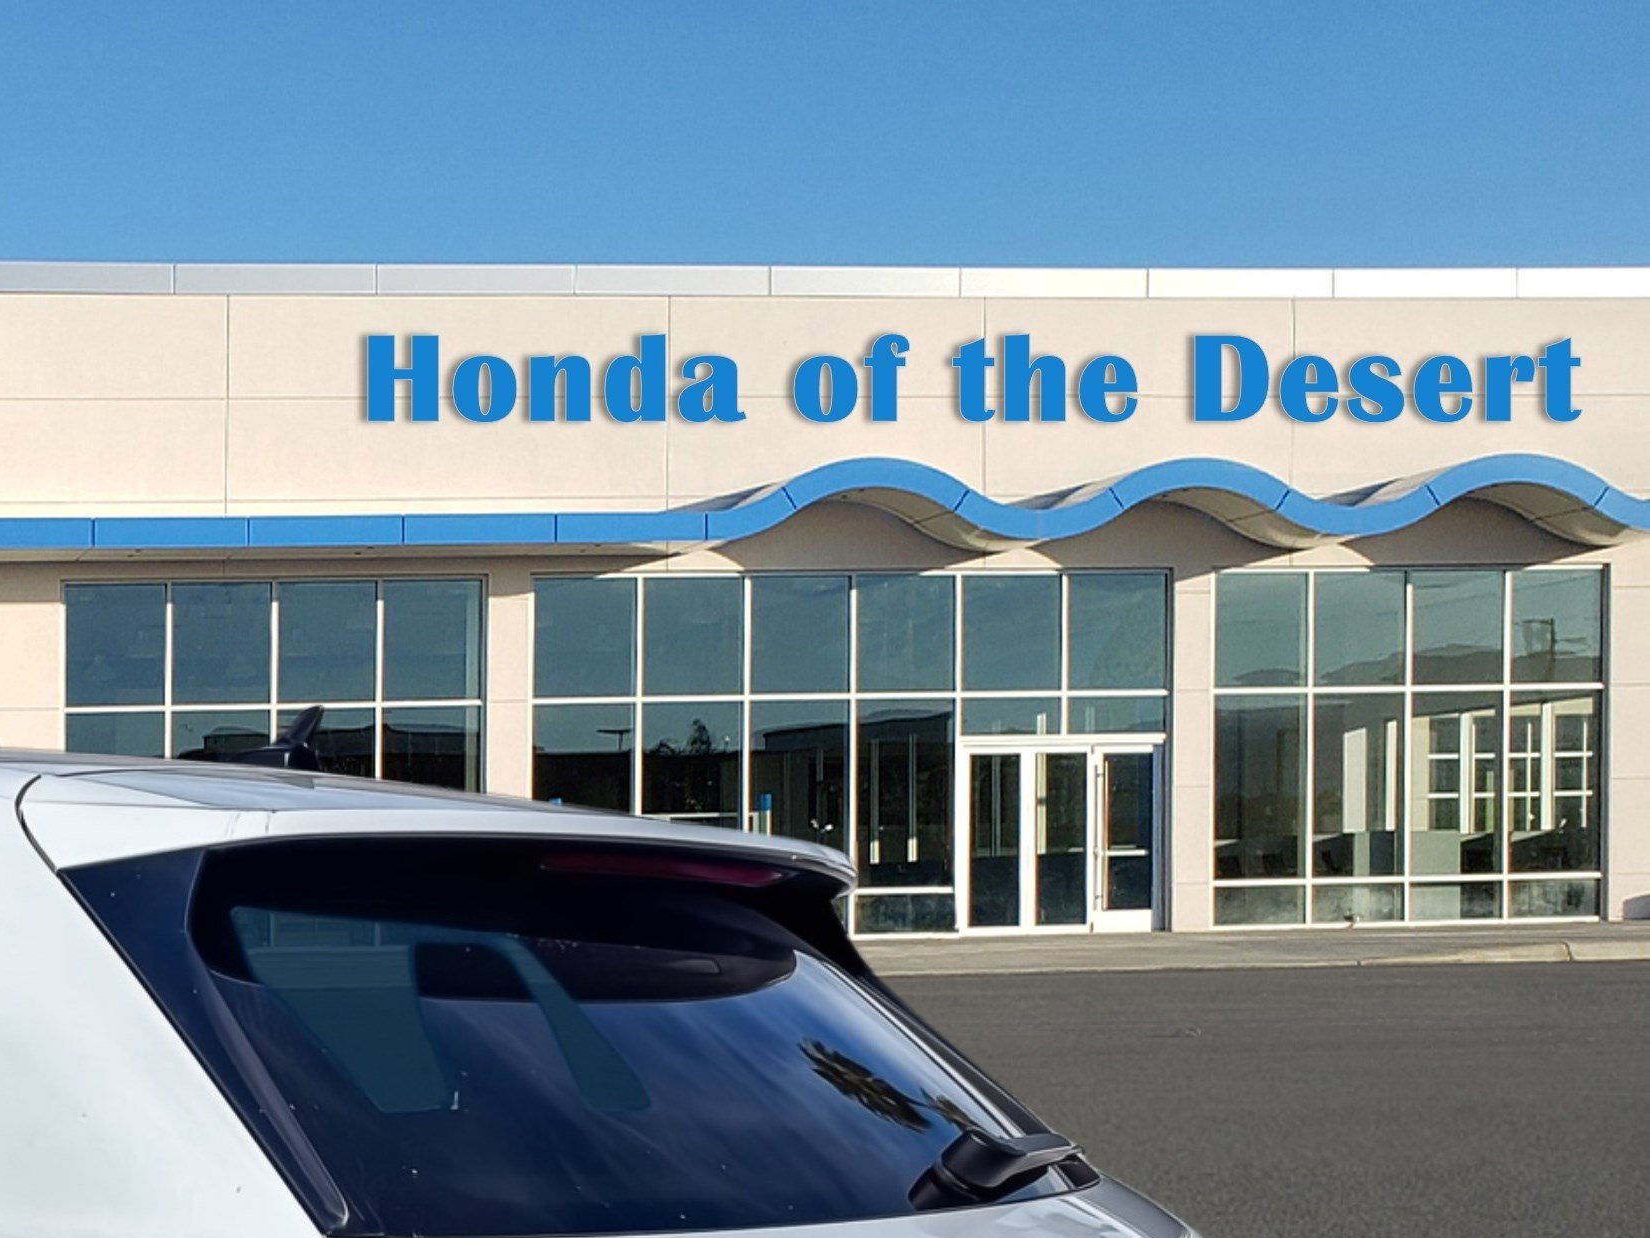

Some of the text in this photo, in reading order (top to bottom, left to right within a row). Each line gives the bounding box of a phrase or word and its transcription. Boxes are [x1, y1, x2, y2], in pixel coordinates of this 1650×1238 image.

[368, 333, 1582, 423] Honda of the Desert
